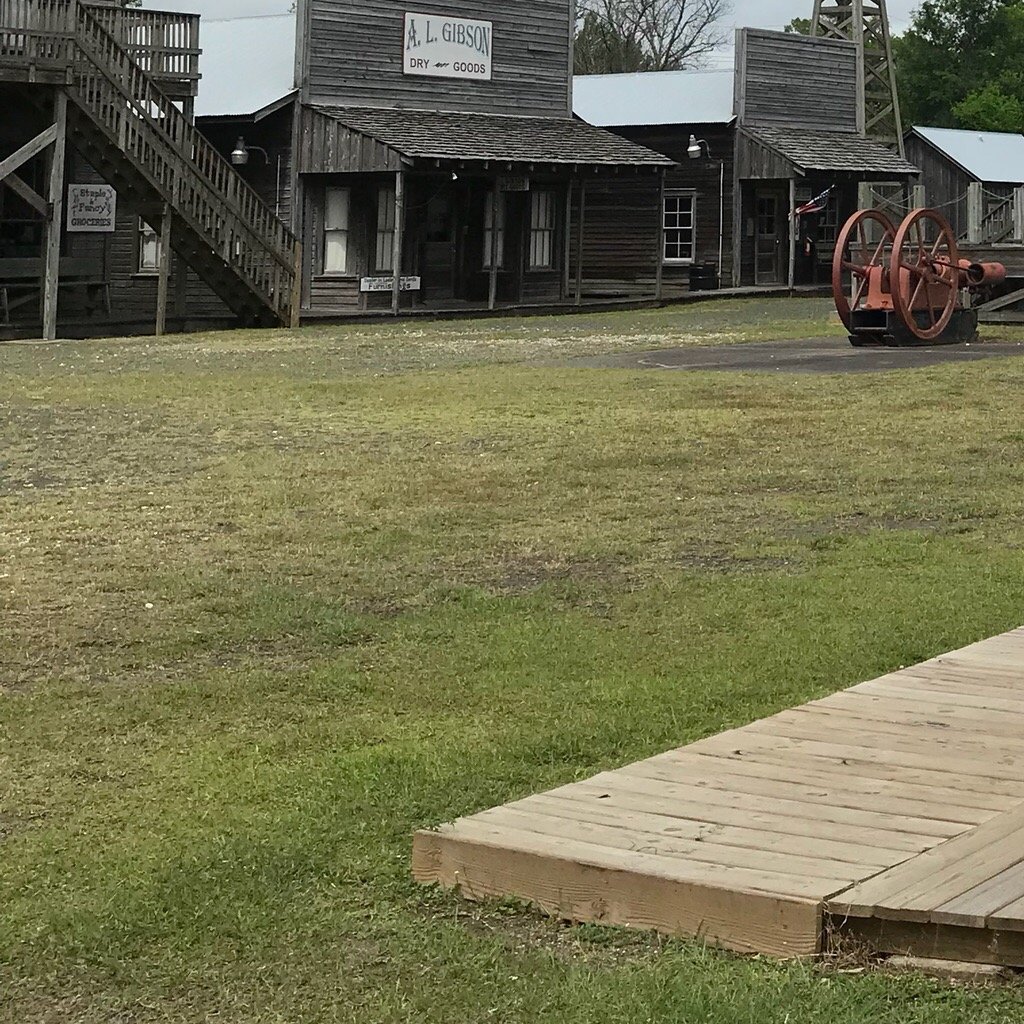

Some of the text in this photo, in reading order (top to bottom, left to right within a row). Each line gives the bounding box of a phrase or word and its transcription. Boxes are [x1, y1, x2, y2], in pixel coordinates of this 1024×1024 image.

[406, 19, 490, 57] A. L. GIBSON
[410, 58, 486, 74] DRY GOODS
[71, 218, 112, 226] GROCERIES
